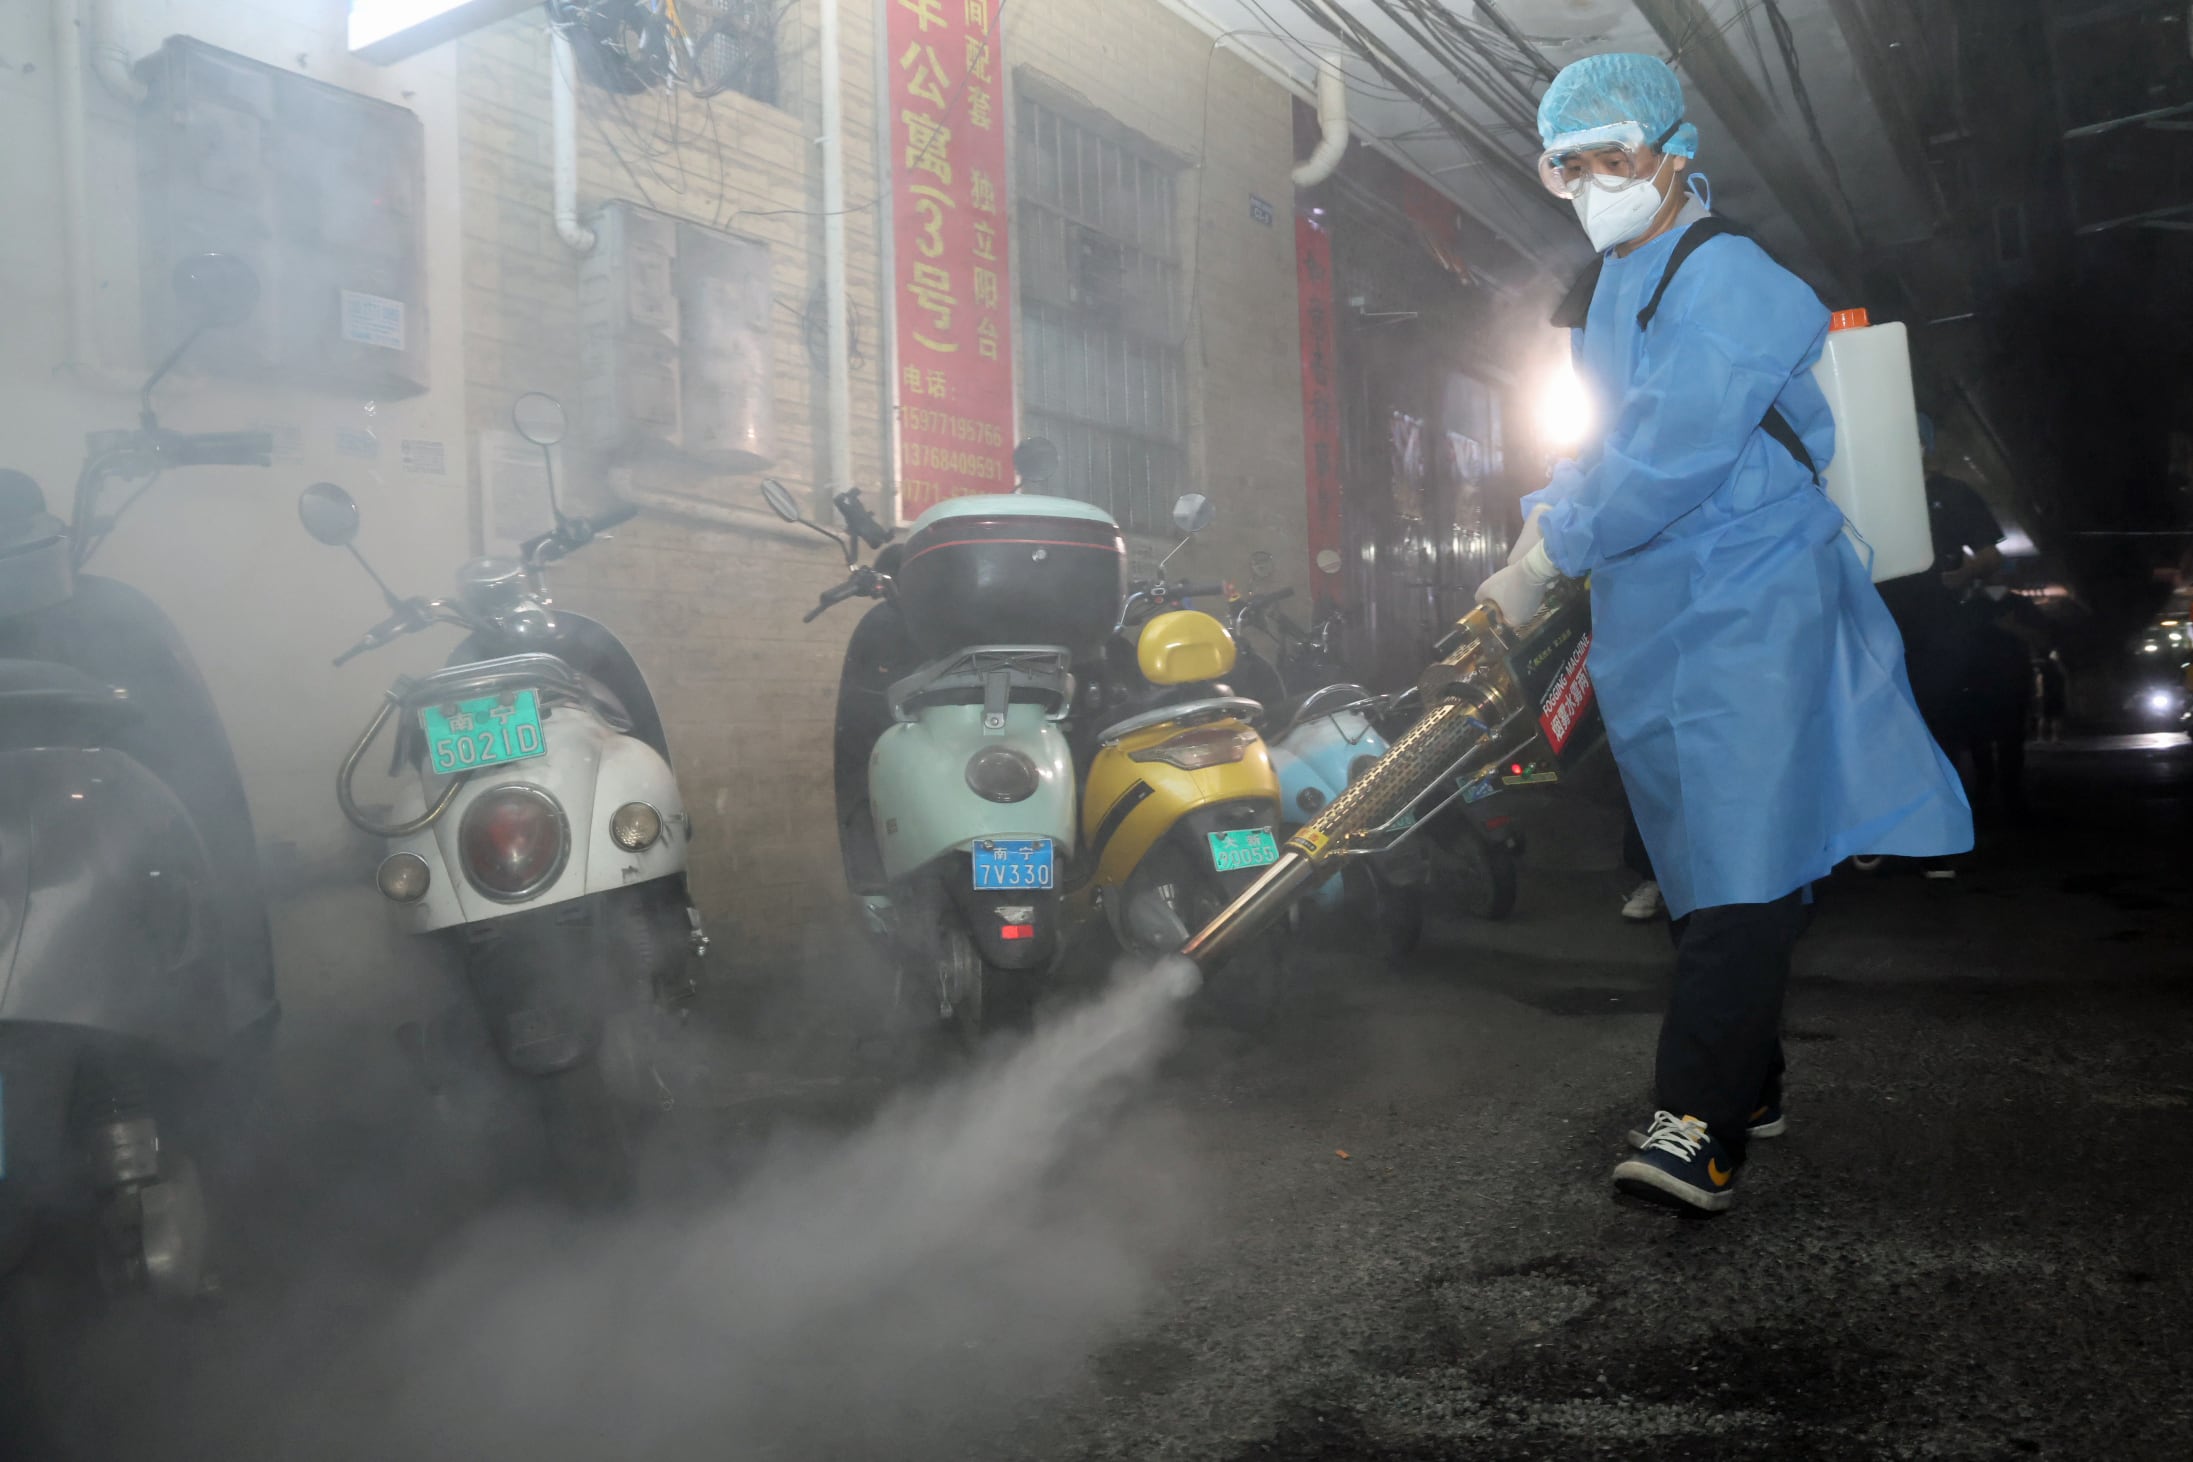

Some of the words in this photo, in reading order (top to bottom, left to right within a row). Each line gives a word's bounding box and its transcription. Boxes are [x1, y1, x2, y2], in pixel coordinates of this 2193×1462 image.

[970, 165, 998, 361] 独立阳台
[1542, 673, 1568, 718] FOGGING
[1565, 632, 1591, 678] MACHINE
[449, 704, 515, 733] 南宁
[1550, 661, 1591, 742] 烟雾水雾两
[436, 724, 539, 768] 5021D
[980, 864, 1049, 885] 7V330
[993, 846, 1035, 861] 南宁
